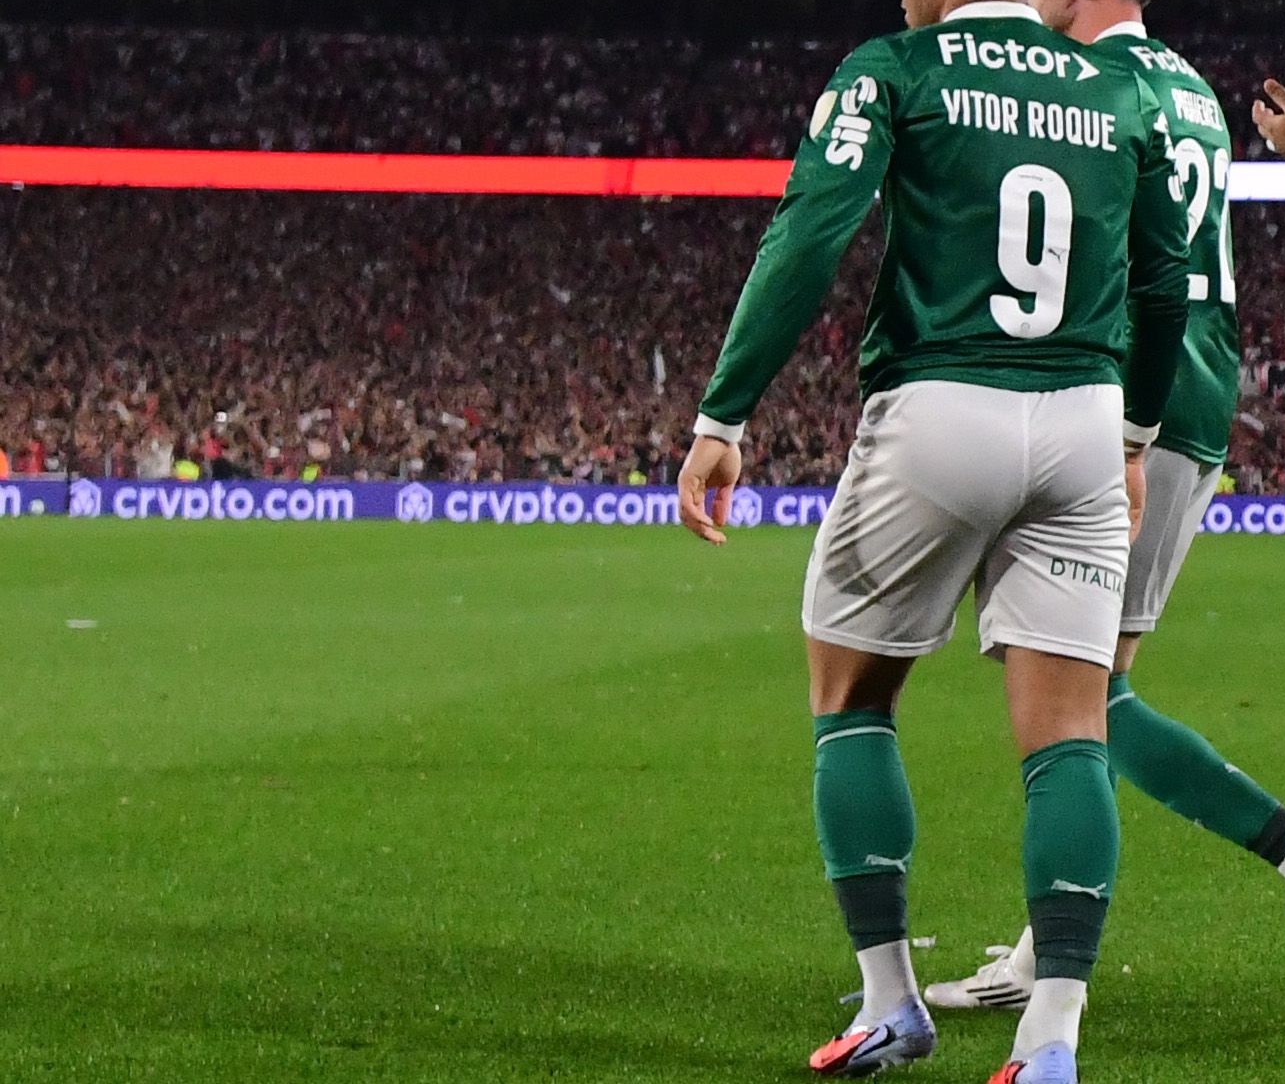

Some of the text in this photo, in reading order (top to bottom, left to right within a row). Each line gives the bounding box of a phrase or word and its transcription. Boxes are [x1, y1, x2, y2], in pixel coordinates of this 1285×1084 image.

[937, 32, 1072, 80] Fictor
[941, 88, 1118, 153] VITOR ROQUE
[989, 163, 1074, 340] 9
[113, 479, 354, 521] crypto.com
[445, 483, 680, 525] crypto.com
